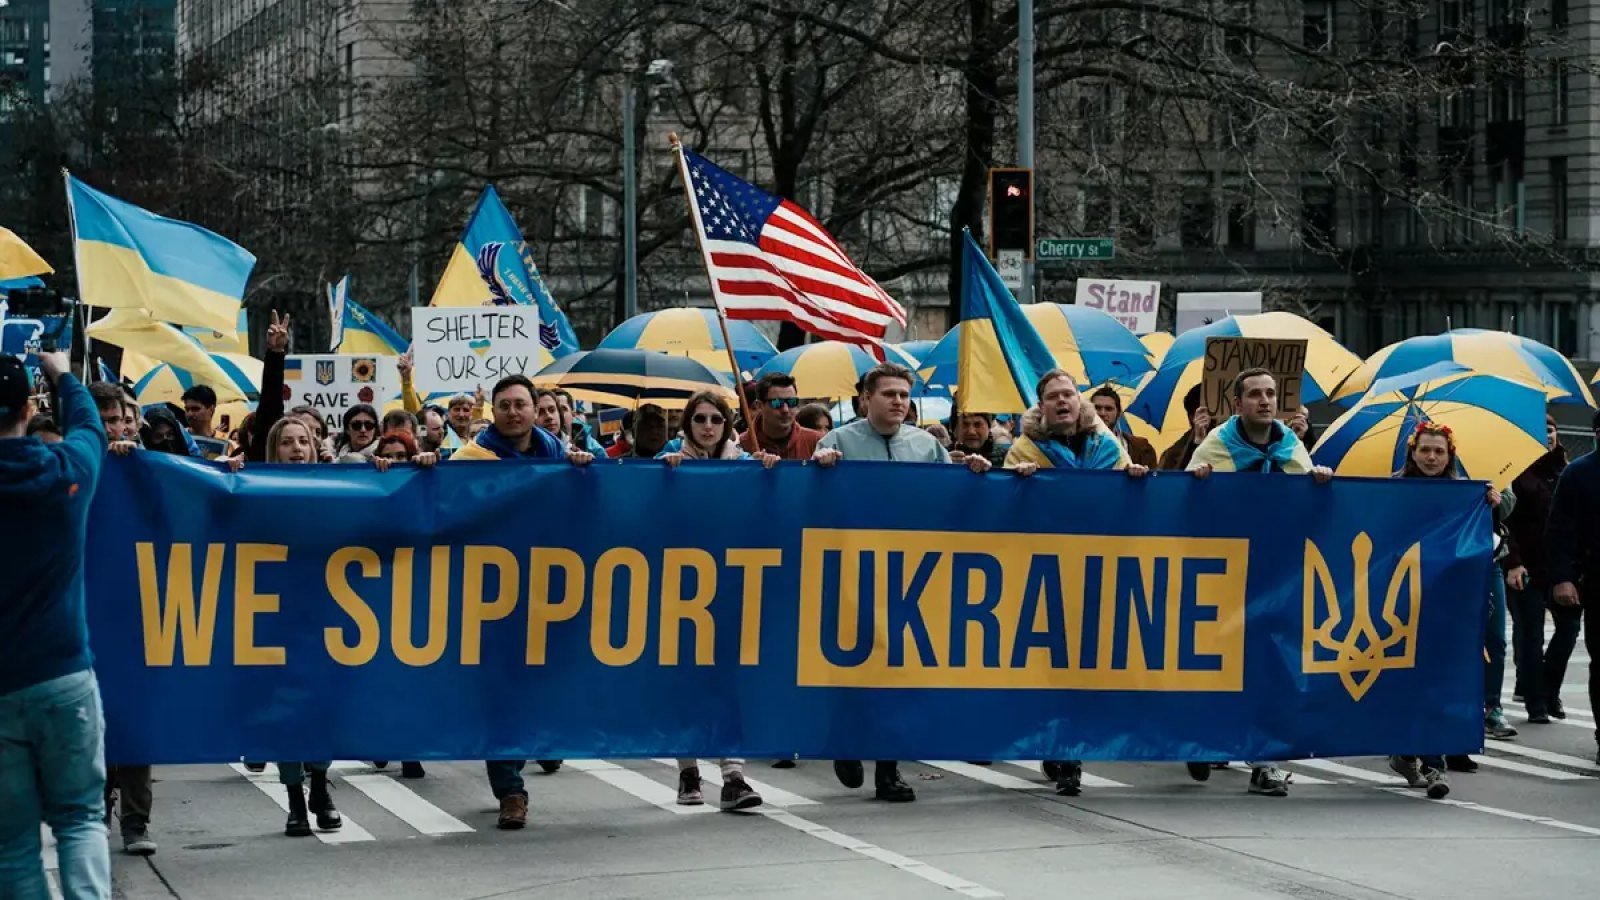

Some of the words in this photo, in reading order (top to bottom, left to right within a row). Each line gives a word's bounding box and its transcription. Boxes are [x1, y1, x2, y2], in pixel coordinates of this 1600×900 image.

[1039, 240, 1085, 258] Cherry
[1088, 244, 1099, 256] St
[1085, 283, 1156, 313] Stand
[427, 313, 528, 343] SHELTER
[436, 356, 480, 381] OUR
[485, 356, 528, 378] SKY
[303, 393, 348, 408] SAVE
[135, 542, 288, 667] WE
[323, 545, 782, 667] SUPPORT
[819, 549, 1227, 671] UKRAINE
